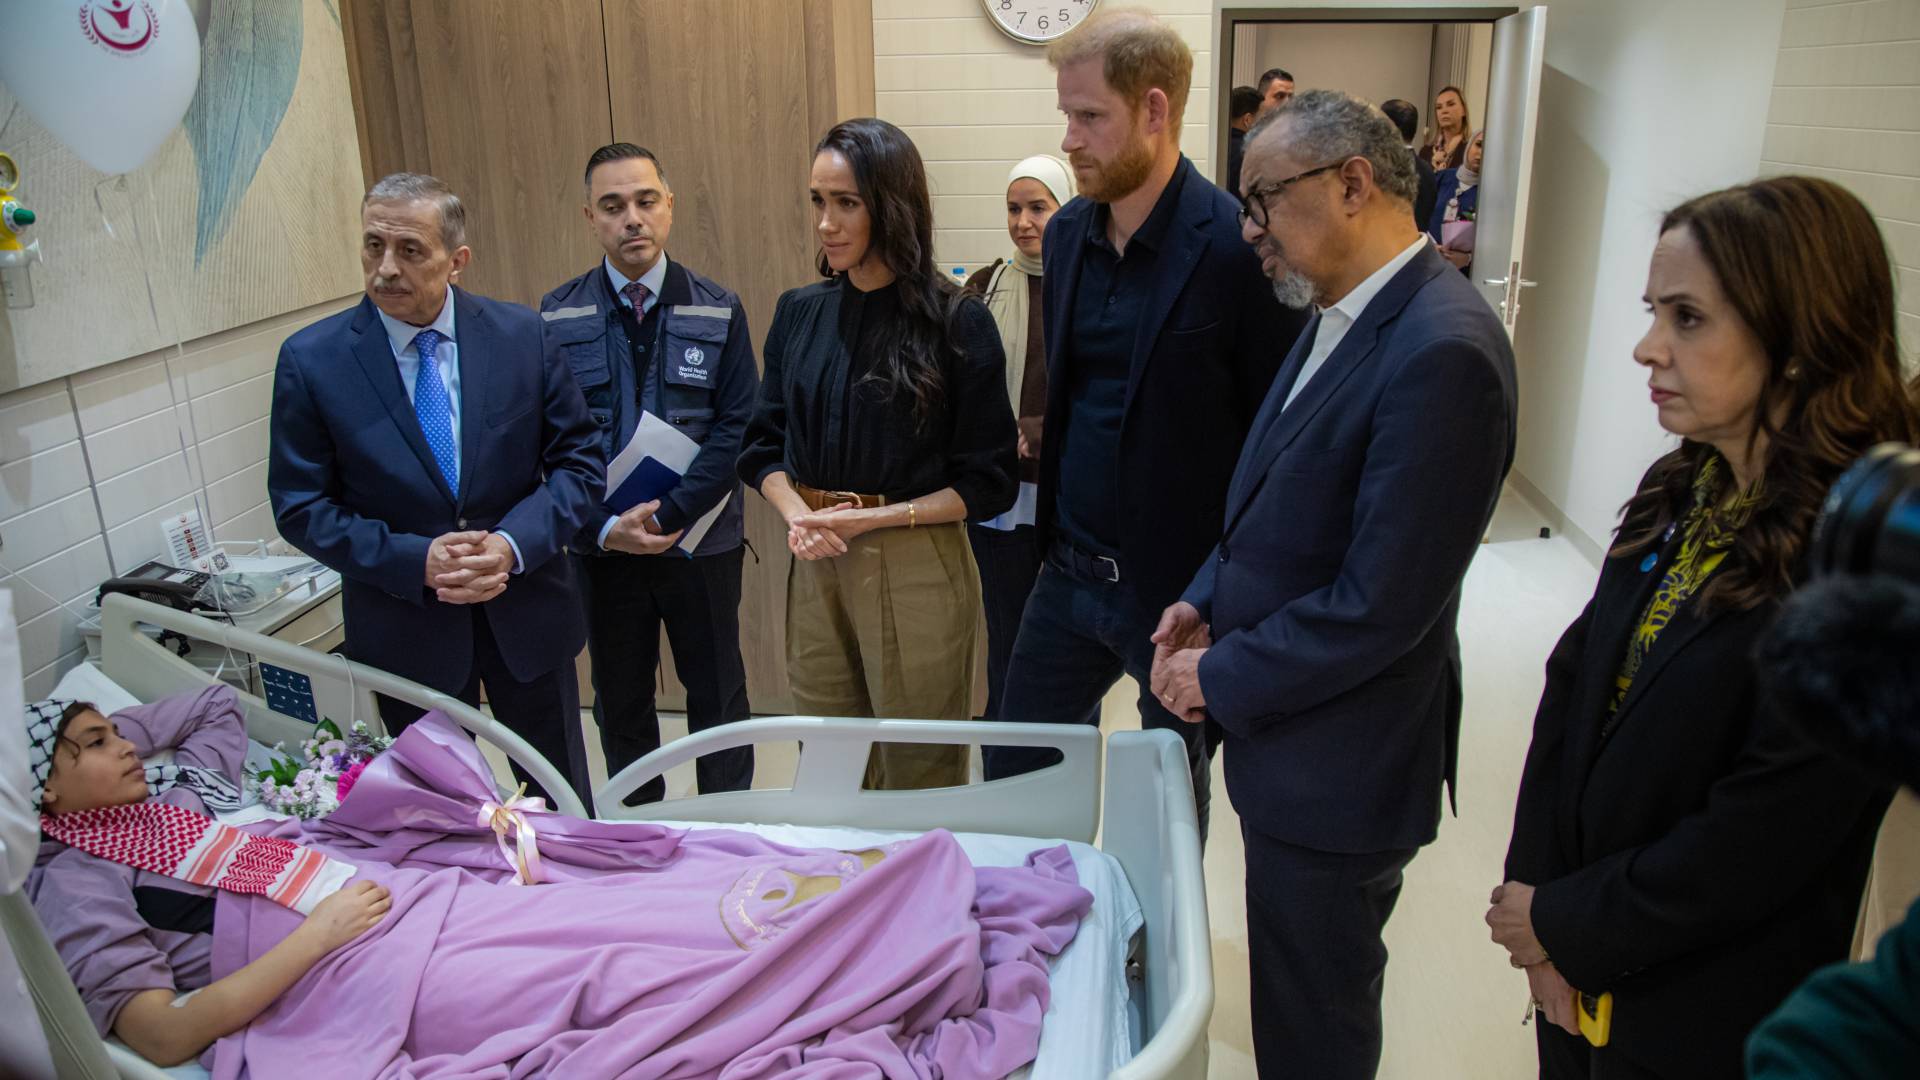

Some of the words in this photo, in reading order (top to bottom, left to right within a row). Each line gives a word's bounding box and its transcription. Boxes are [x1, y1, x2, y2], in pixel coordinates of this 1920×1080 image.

[1001, 0, 1012, 10] 8
[1017, 11, 1028, 24] 7
[1058, 9, 1070, 22] 5
[1038, 15, 1049, 30] 6
[693, 368, 707, 376] Health
